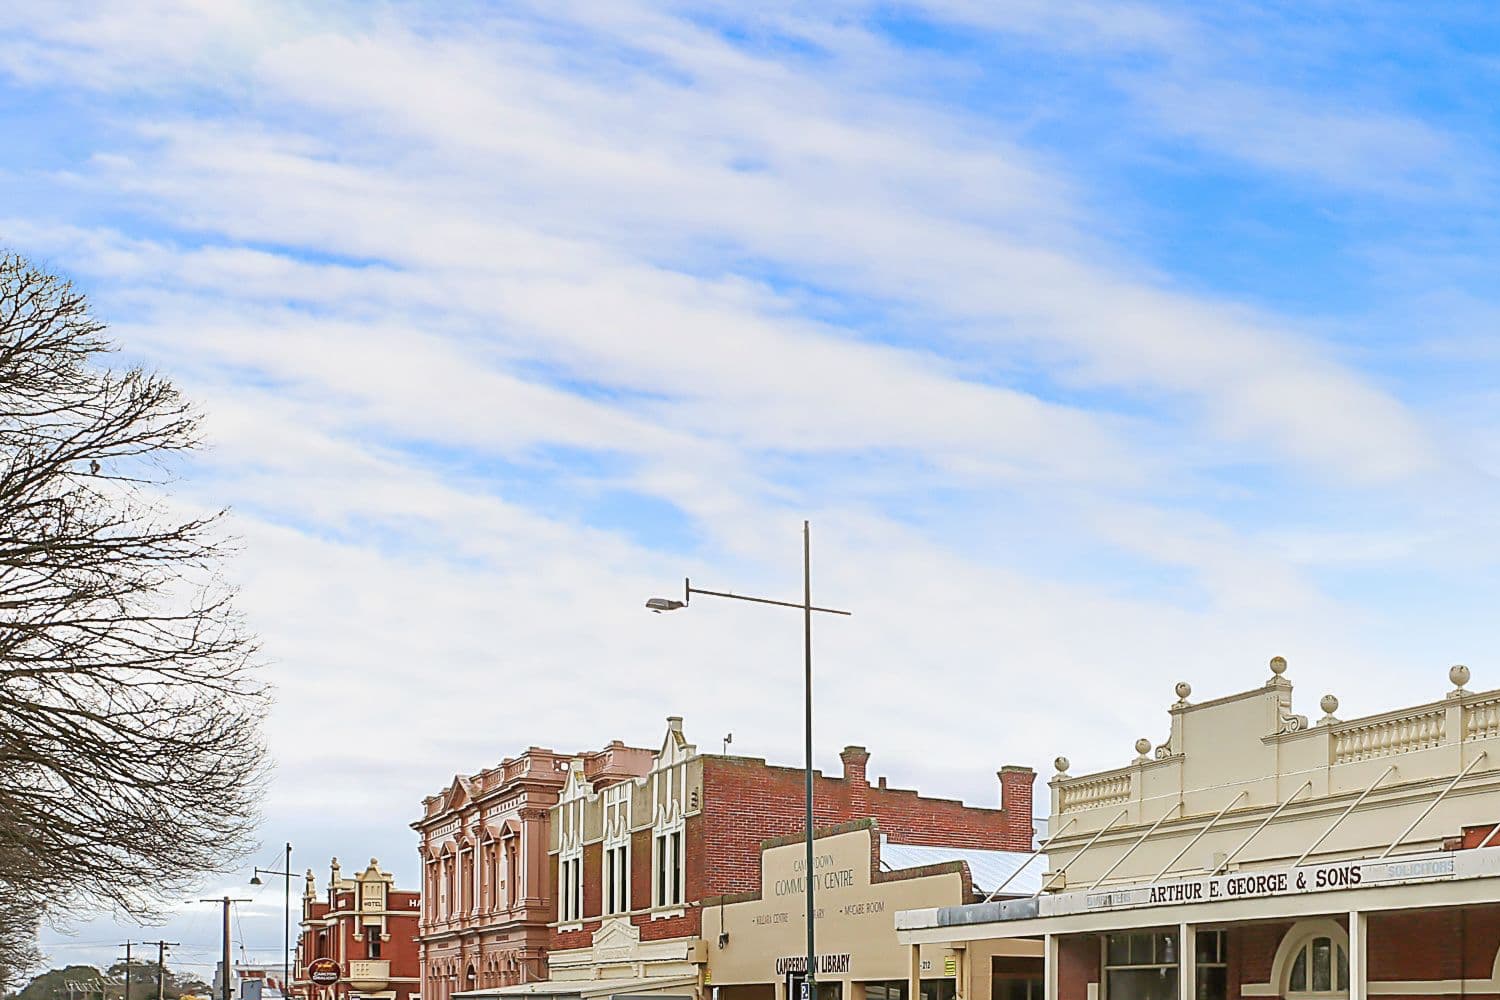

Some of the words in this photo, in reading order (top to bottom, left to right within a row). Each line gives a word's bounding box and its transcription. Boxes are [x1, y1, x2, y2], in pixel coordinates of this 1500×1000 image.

[793, 854, 834, 872] CAMDOWN
[775, 874, 822, 896] COMMUTY
[824, 869, 854, 889] CENTRE
[1150, 882, 1203, 903] ARTHUR
[1209, 880, 1223, 898] E.
[1227, 873, 1288, 896] GEORGE
[1295, 871, 1307, 889] &
[1315, 865, 1362, 888] SONS
[776, 956, 819, 975] CAMPERDON
[821, 954, 850, 973] LIBRARY
